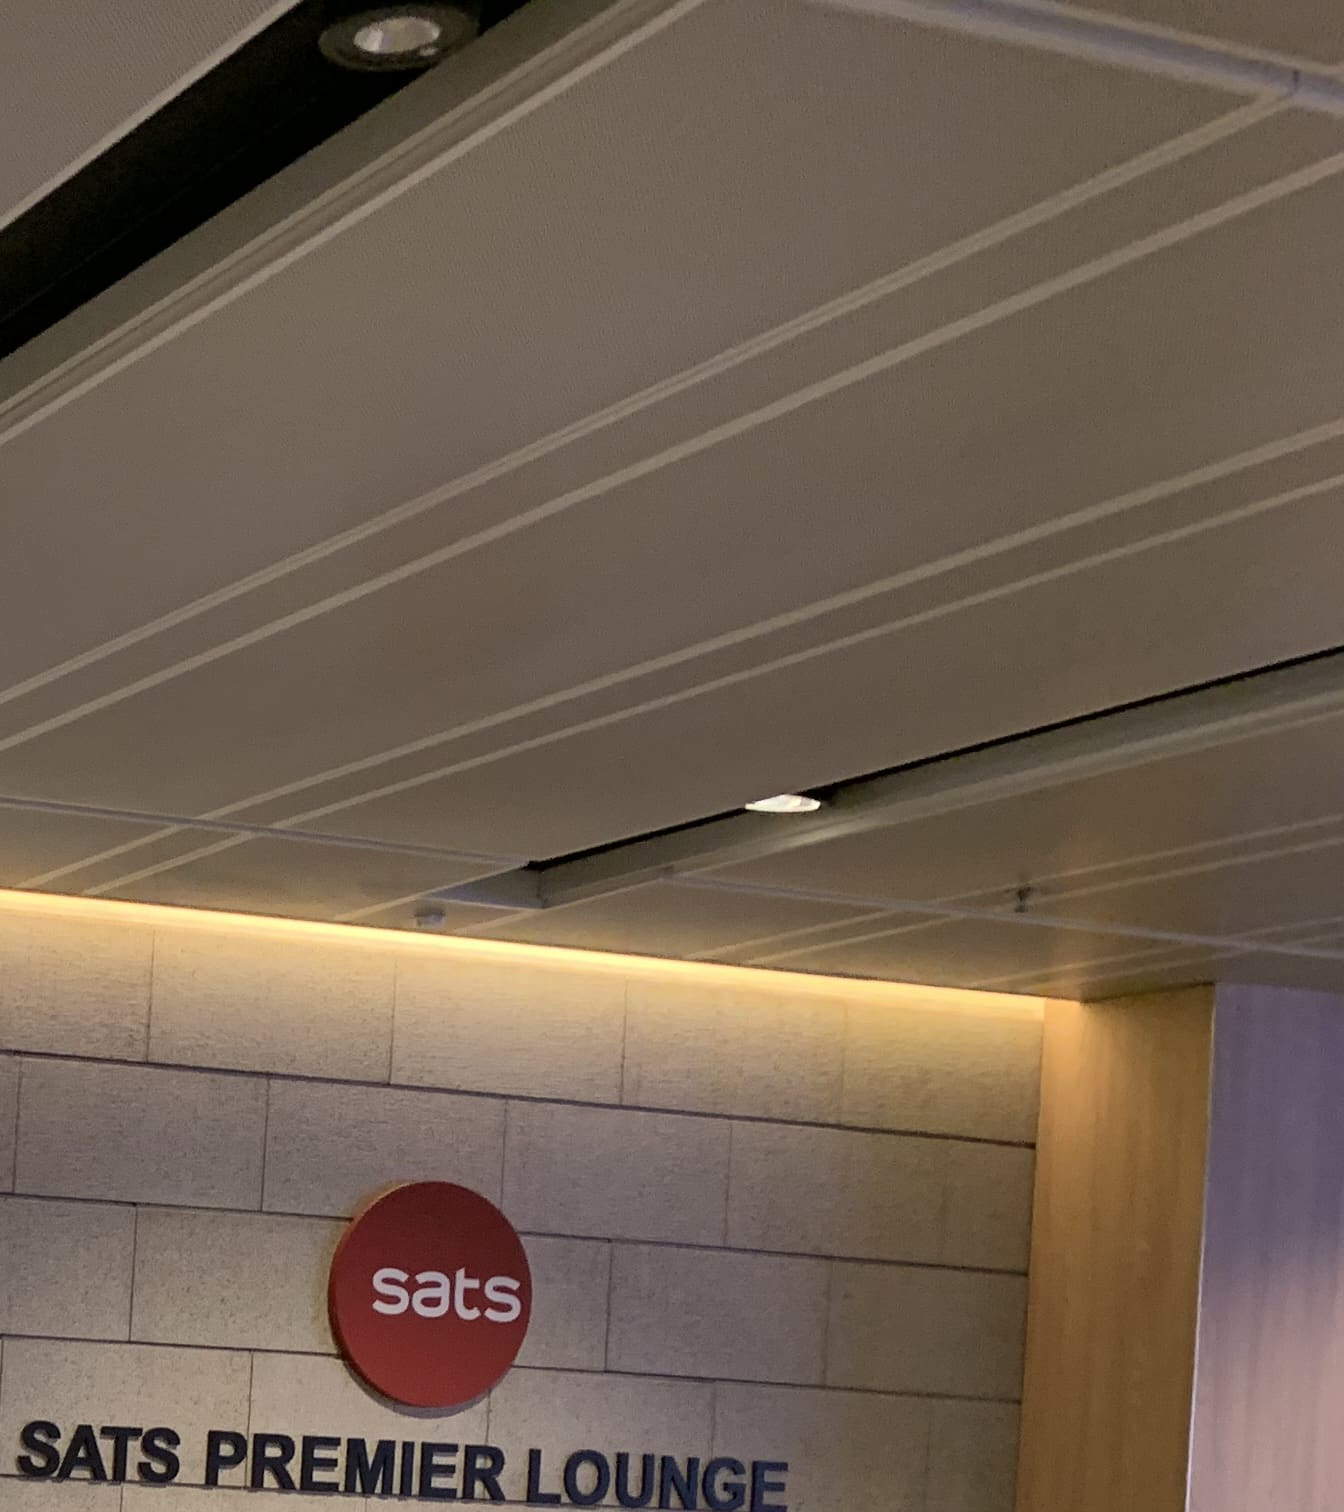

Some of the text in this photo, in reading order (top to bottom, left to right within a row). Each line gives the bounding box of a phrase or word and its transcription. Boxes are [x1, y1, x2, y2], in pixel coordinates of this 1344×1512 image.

[372, 1267, 521, 1323] sats
[16, 1420, 181, 1486] SATS
[205, 1430, 507, 1503] PREMIER
